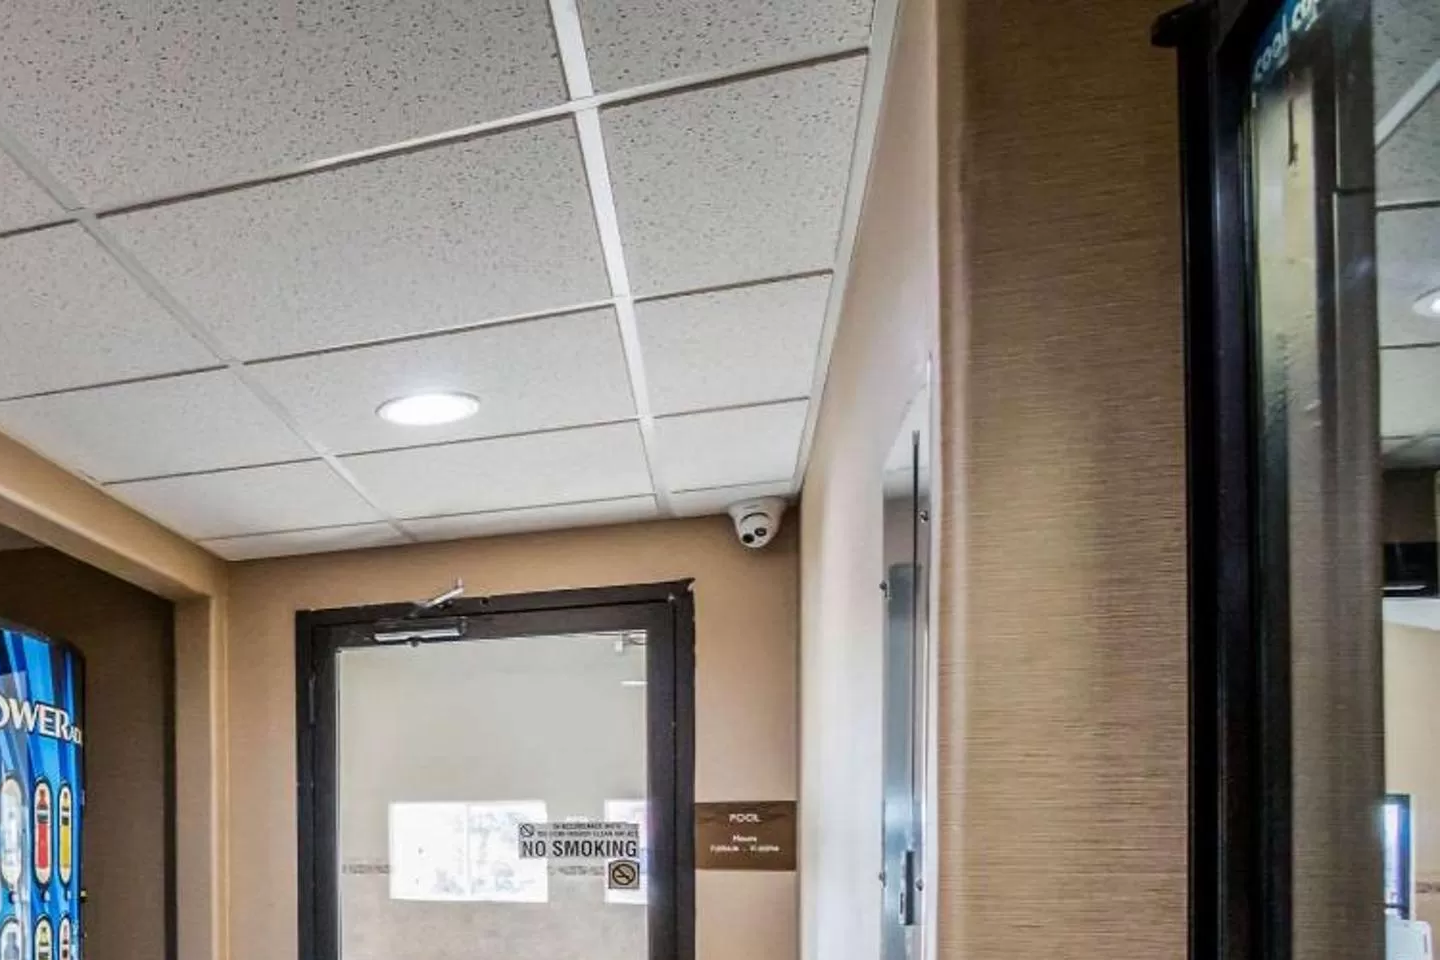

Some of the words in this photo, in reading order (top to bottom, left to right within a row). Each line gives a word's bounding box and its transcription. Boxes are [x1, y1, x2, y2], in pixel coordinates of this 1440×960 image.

[728, 813, 762, 823] POOL
[521, 840, 546, 858] NO
[552, 840, 637, 858] SMOKING
